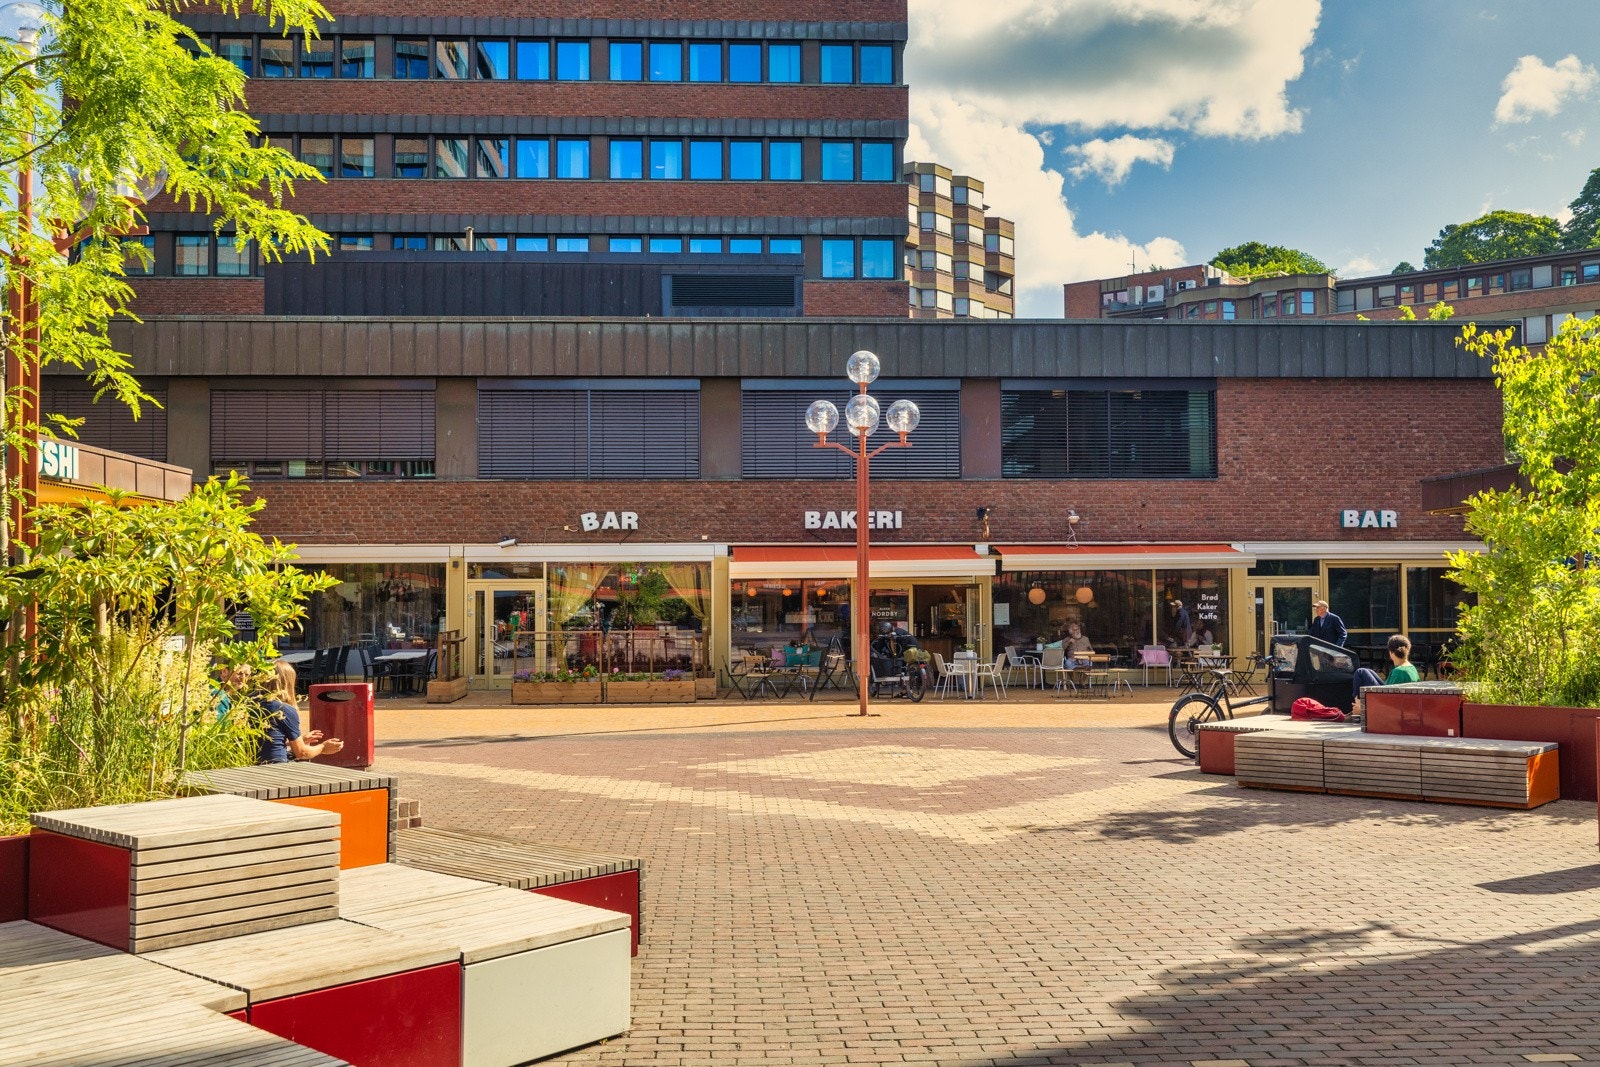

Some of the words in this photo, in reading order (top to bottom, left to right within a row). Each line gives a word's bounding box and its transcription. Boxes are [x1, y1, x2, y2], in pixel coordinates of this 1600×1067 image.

[580, 511, 639, 531] BAR
[1341, 510, 1398, 528] BAR
[1197, 602, 1218, 610] Kaker
[1198, 612, 1218, 620] Kaffe
